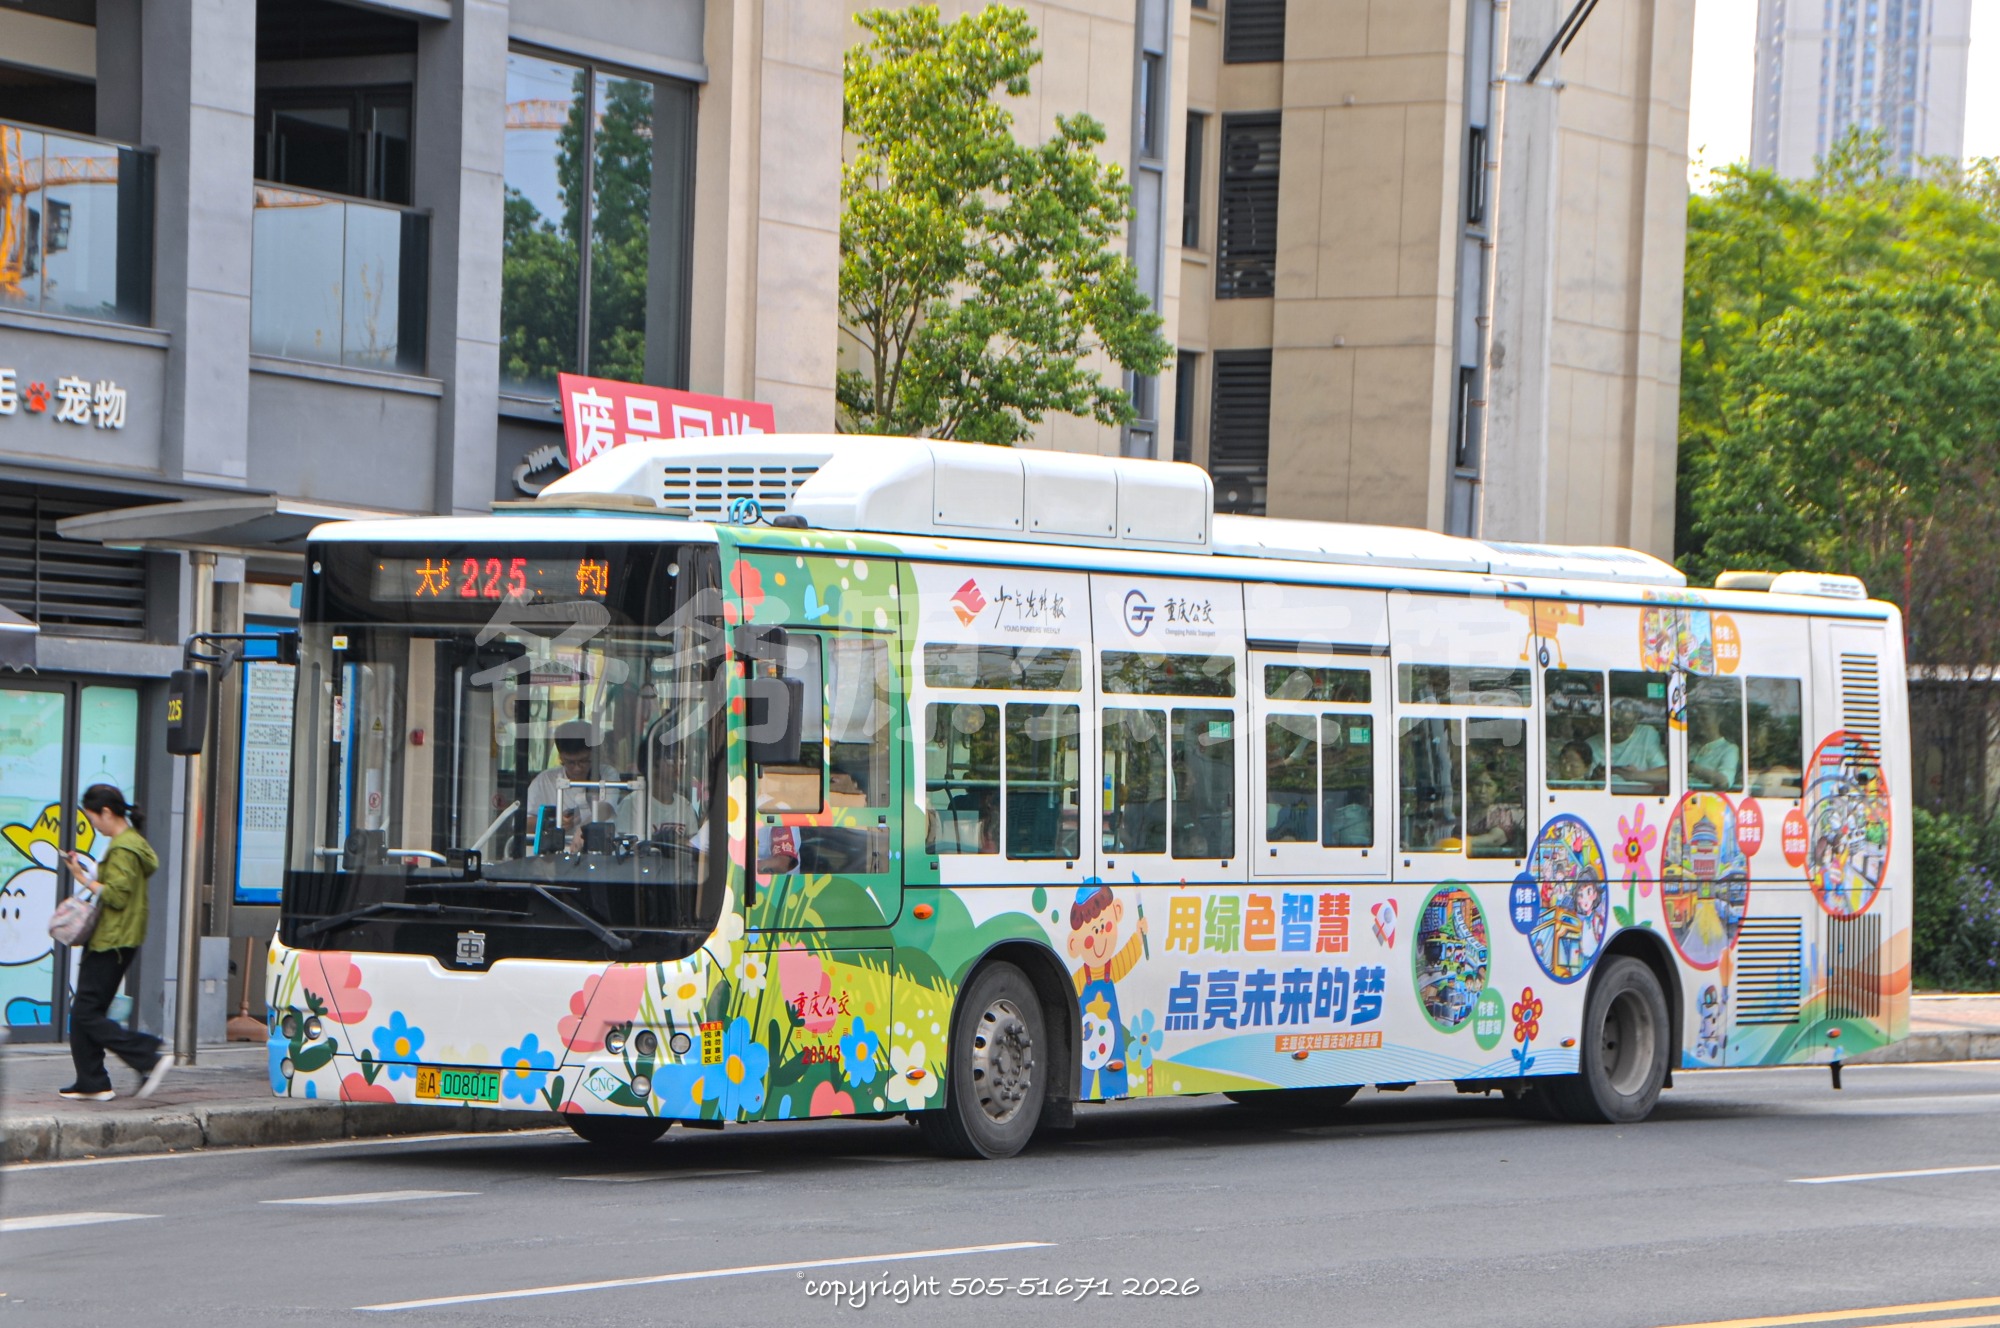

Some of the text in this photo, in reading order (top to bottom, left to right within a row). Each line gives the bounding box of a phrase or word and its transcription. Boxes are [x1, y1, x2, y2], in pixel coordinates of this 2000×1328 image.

[56, 375, 126, 429] 宠物
[461, 558, 527, 597] 225
[1164, 598, 1214, 624] 重庆公交
[167, 699, 182, 721] 225
[1165, 892, 1351, 955] 用绿色智慧
[793, 990, 852, 1018] 重庆公交
[1164, 966, 1386, 1031] 点亮未来的梦
[589, 1076, 616, 1092] CNG
